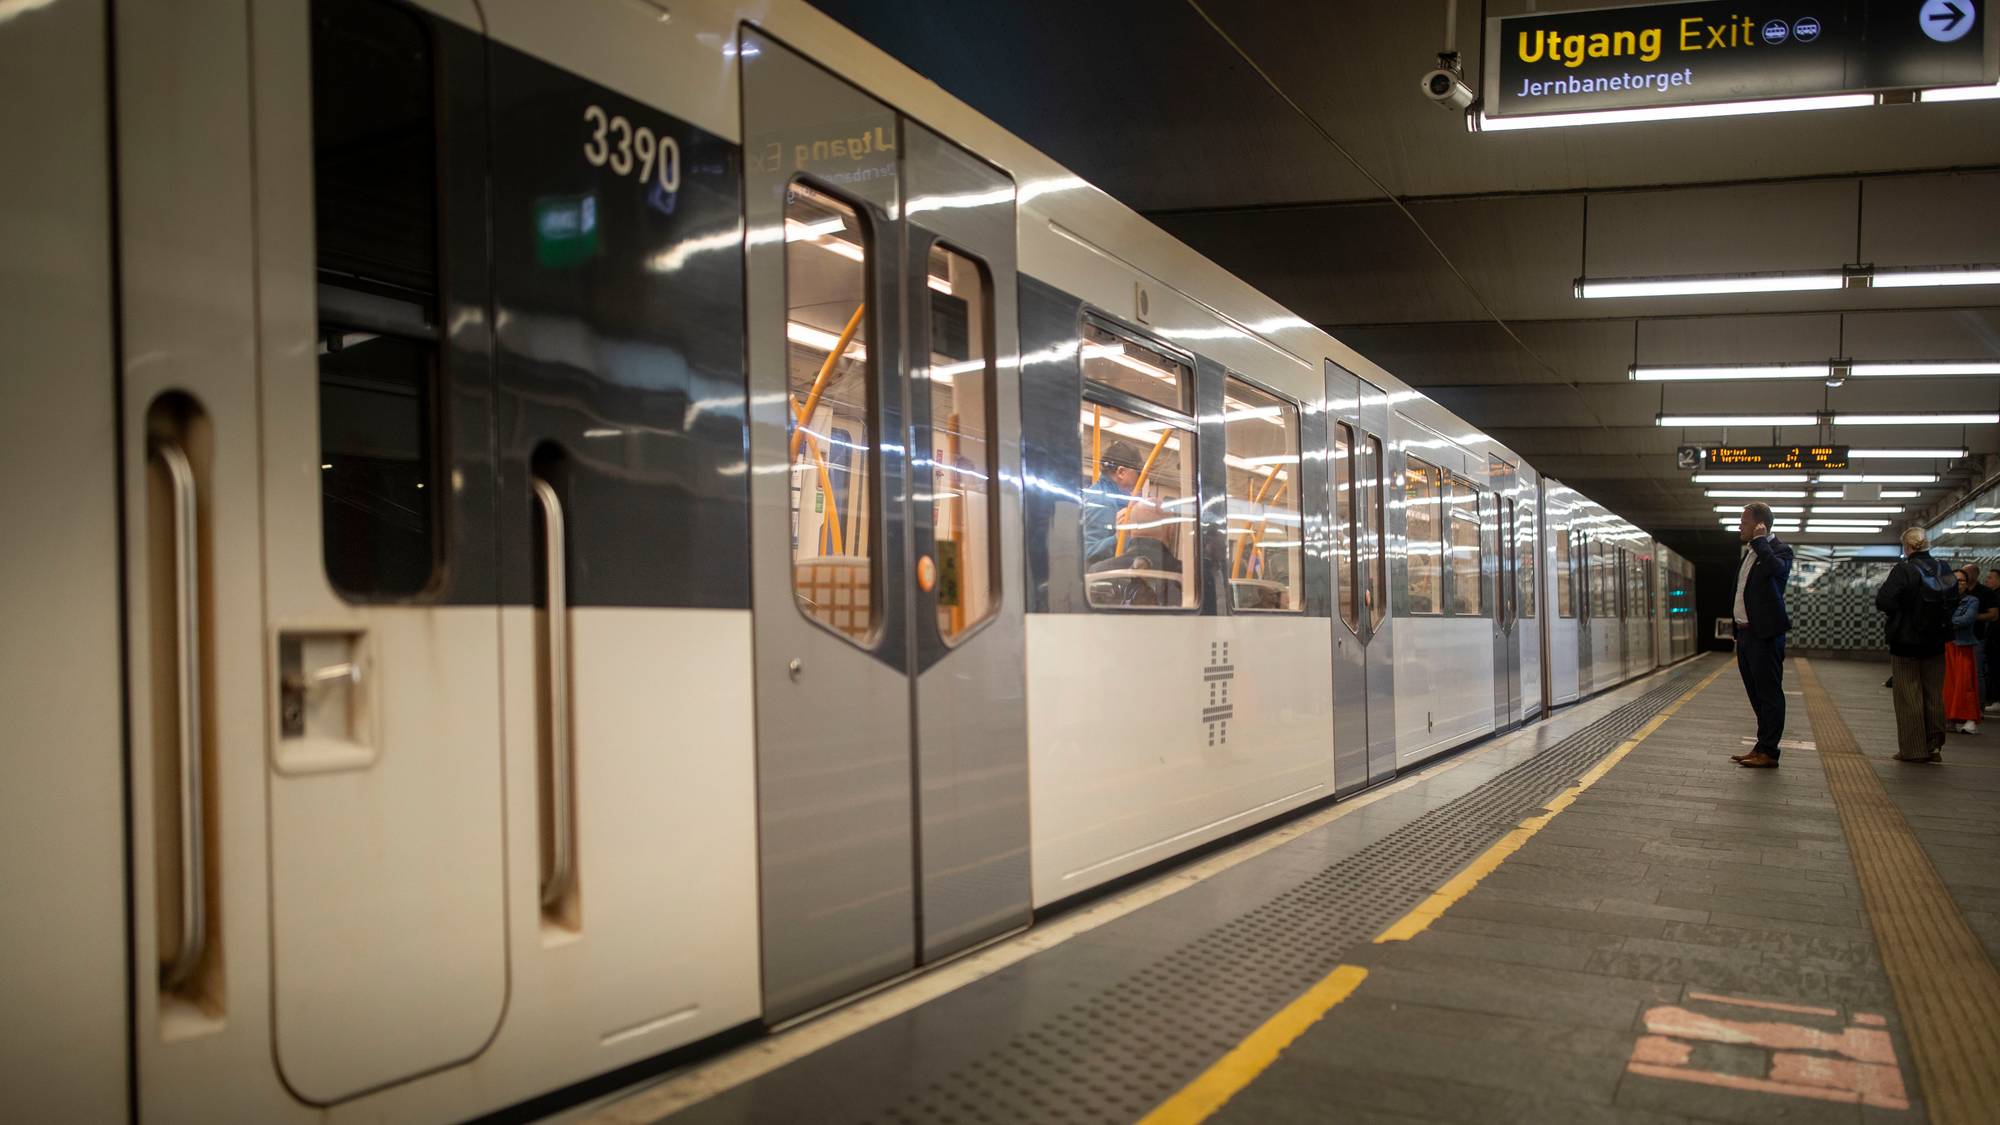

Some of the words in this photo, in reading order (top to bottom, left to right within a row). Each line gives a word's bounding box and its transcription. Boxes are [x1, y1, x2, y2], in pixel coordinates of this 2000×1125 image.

[1518, 28, 1662, 68] Utgang
[1679, 14, 1755, 51] Exit
[1517, 67, 1693, 97] Jernbanetorget
[583, 105, 681, 193] 3390
[1683, 449, 1695, 463] 2
